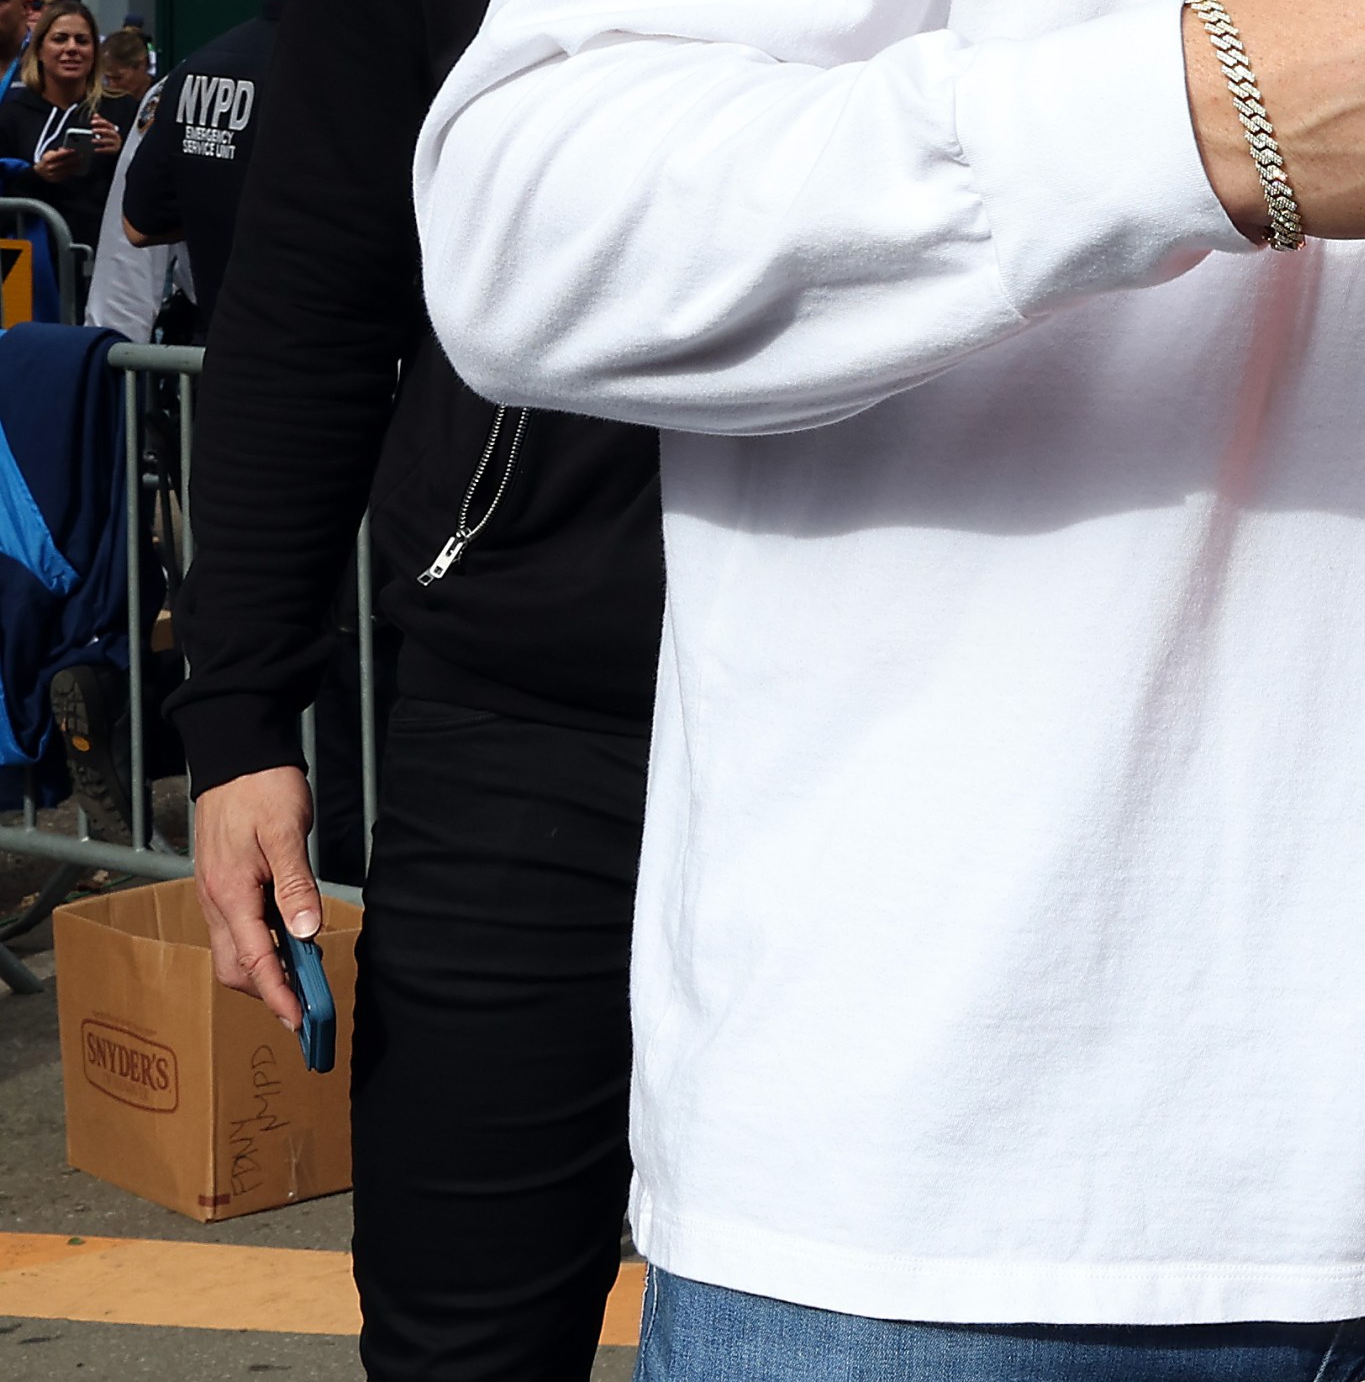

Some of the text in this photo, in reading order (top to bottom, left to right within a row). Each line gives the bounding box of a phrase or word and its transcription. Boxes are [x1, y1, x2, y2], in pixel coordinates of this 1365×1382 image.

[175, 74, 255, 131] NYPD
[182, 139, 236, 160] SERVICE UNIT
[184, 125, 235, 145] EMERGENCY
[86, 1031, 170, 1092] SNYDER'S
